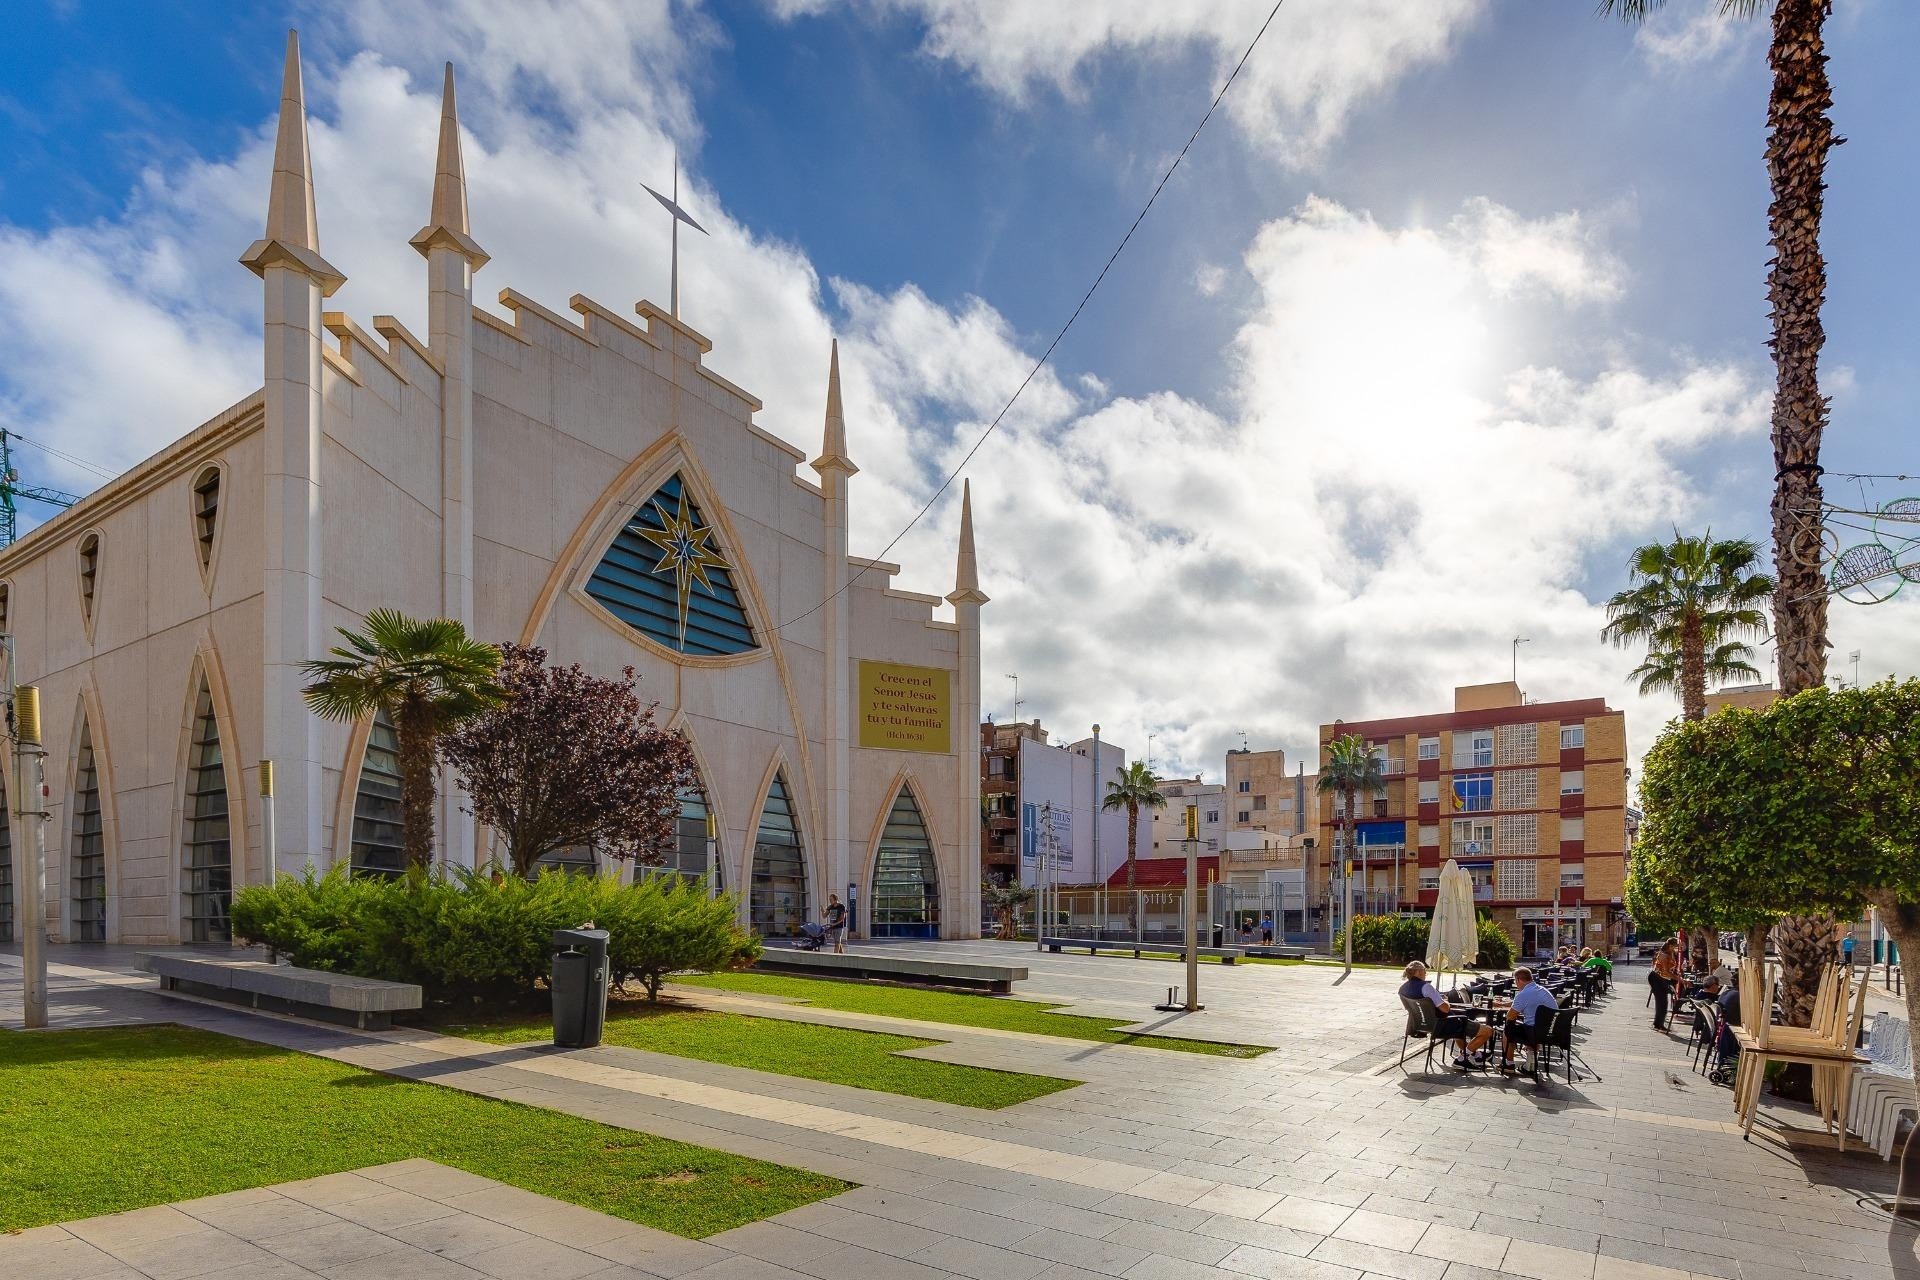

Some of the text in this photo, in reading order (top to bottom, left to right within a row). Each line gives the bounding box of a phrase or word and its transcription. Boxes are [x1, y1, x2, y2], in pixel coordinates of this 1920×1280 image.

[907, 677, 920, 686] en
[922, 678, 932, 687] el
[907, 689, 937, 701] Jesús
[872, 702, 879, 711] y
[881, 701, 892, 711] te
[879, 716, 888, 726] y
[890, 715, 902, 725] tu
